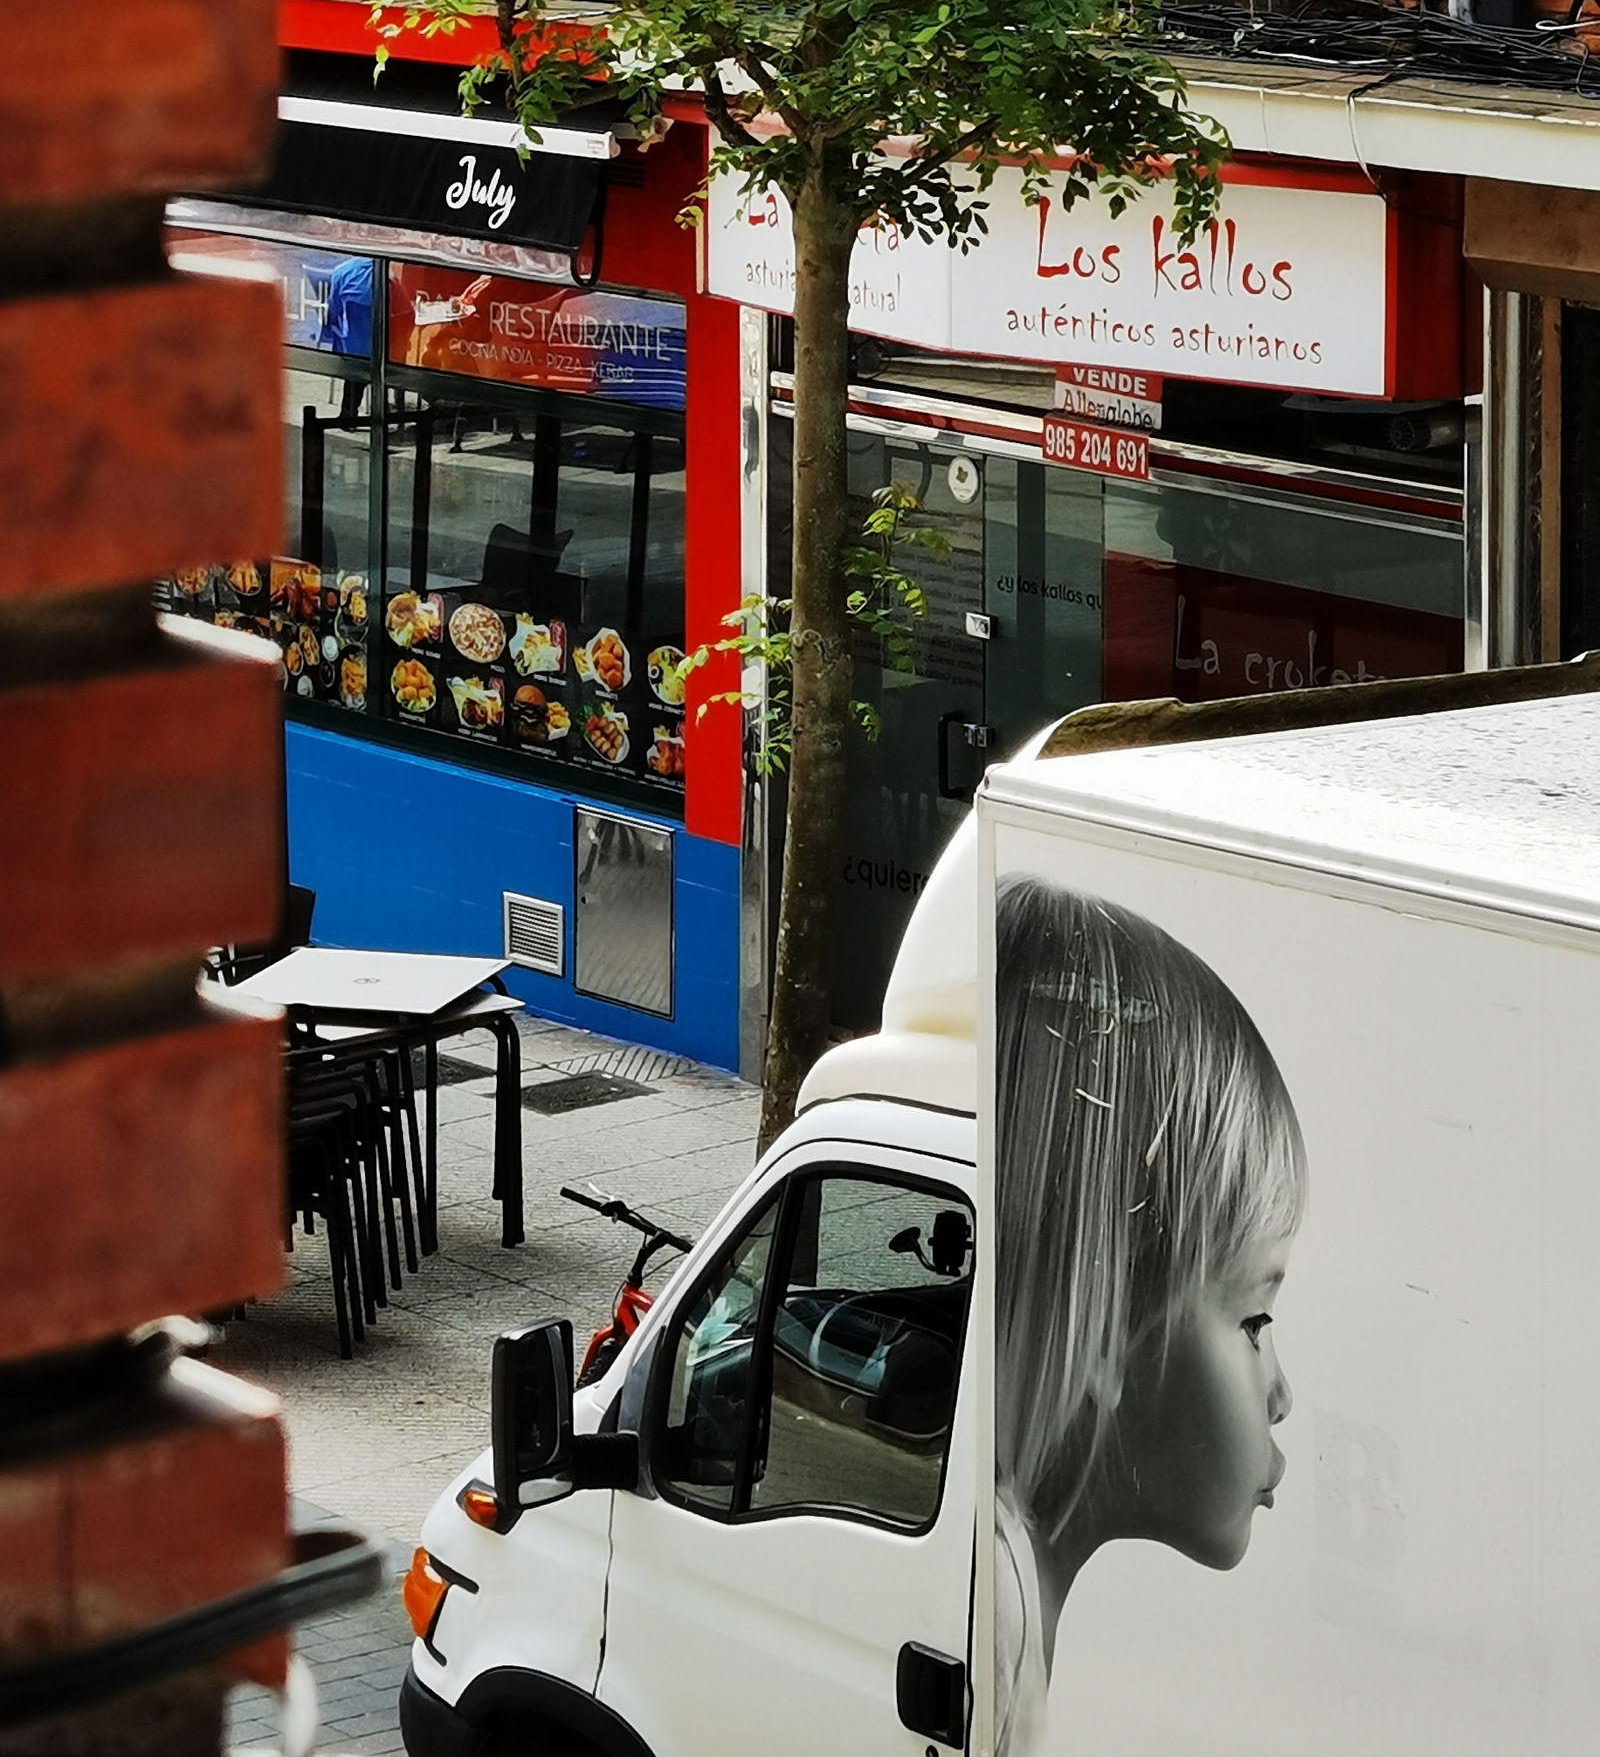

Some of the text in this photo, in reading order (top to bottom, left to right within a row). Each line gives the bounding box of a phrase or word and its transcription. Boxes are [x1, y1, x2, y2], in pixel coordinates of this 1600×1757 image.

[445, 155, 516, 229] July
[1037, 196, 1293, 300] Los kallos
[746, 259, 900, 312] asturia atural
[489, 301, 672, 362] RESTAURANTE
[1006, 303, 1323, 364] auténticos asturianos
[1073, 367, 1147, 397] VENDE
[1045, 424, 1146, 476] 985 204 691
[1017, 574, 1039, 595] los
[1041, 579, 1083, 604] kallos
[1175, 595, 1385, 689] La croket
